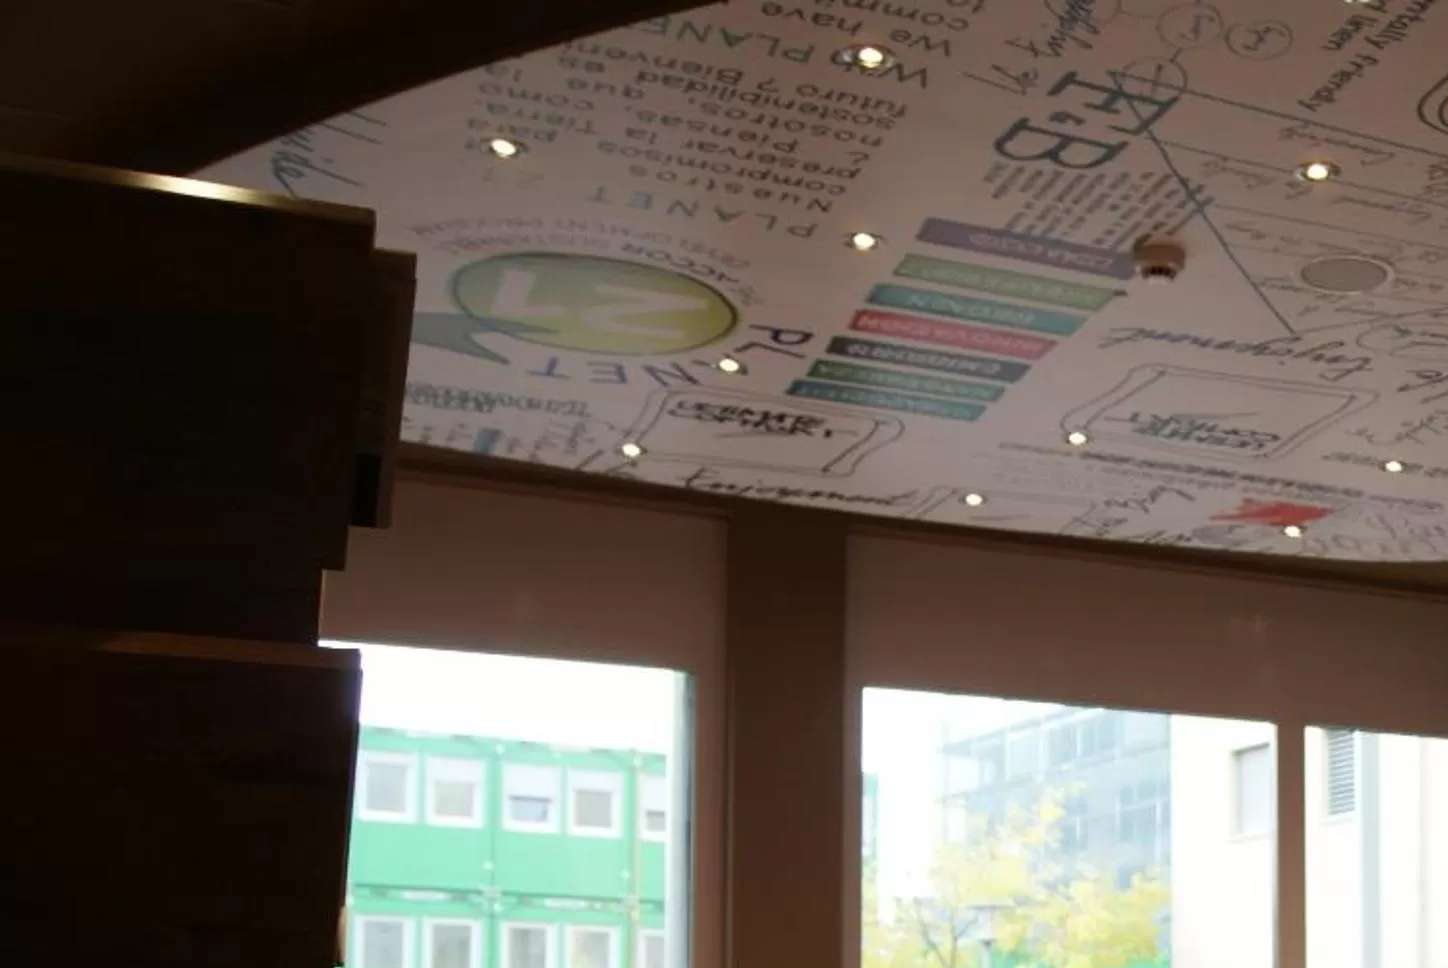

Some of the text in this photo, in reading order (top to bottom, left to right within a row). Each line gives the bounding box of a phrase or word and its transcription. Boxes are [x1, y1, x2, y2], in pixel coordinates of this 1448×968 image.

[760, 3, 951, 58] We have
[478, 82, 594, 111] como
[558, 56, 895, 131] sostenibilidad es
[567, 77, 645, 101] que
[795, 84, 908, 118] futuro
[1296, 53, 1379, 113] friendly
[624, 127, 657, 145] la
[687, 97, 883, 148] nosotros,
[467, 119, 846, 196] compromisos para
[680, 139, 862, 181] preservar
[585, 185, 818, 239] PLANET
[628, 166, 833, 214] Nuestros
[488, 268, 707, 341] 21
[527, 323, 814, 388] PLNET
[1096, 335, 1372, 382] Enjoyment
